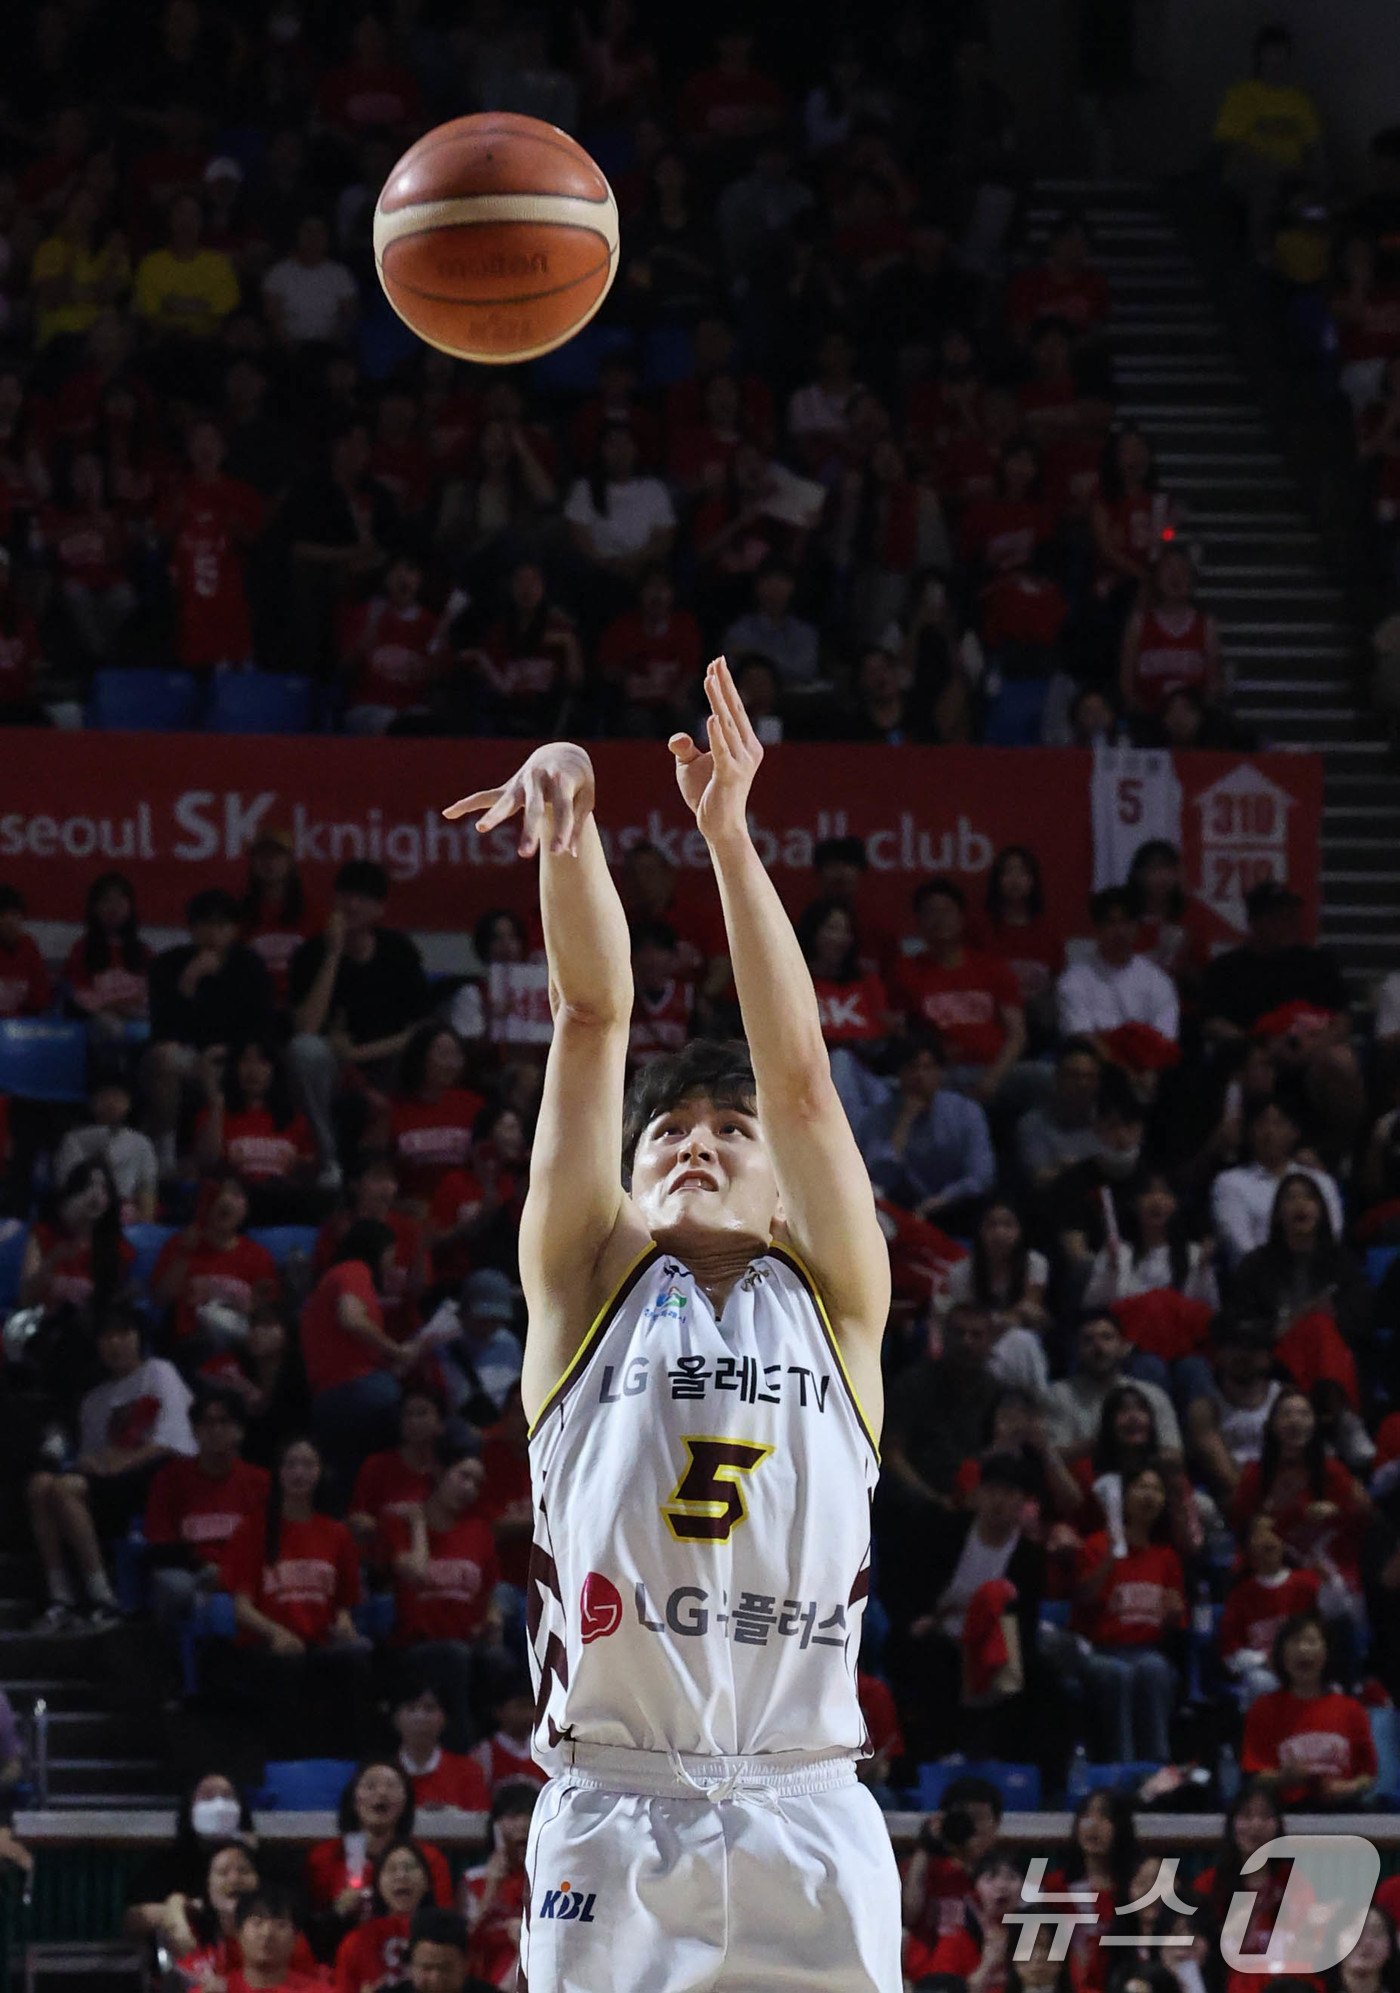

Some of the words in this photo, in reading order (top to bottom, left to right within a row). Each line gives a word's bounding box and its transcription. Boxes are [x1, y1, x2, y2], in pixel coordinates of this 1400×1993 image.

[1118, 777, 1144, 825] 5
[0, 800, 152, 858] seoul
[173, 788, 277, 861] SK
[293, 803, 519, 880] knights
[864, 810, 995, 873] club
[599, 1356, 650, 1404] LG
[660, 1435, 774, 1545] 5
[540, 1889, 597, 1922] KBL
